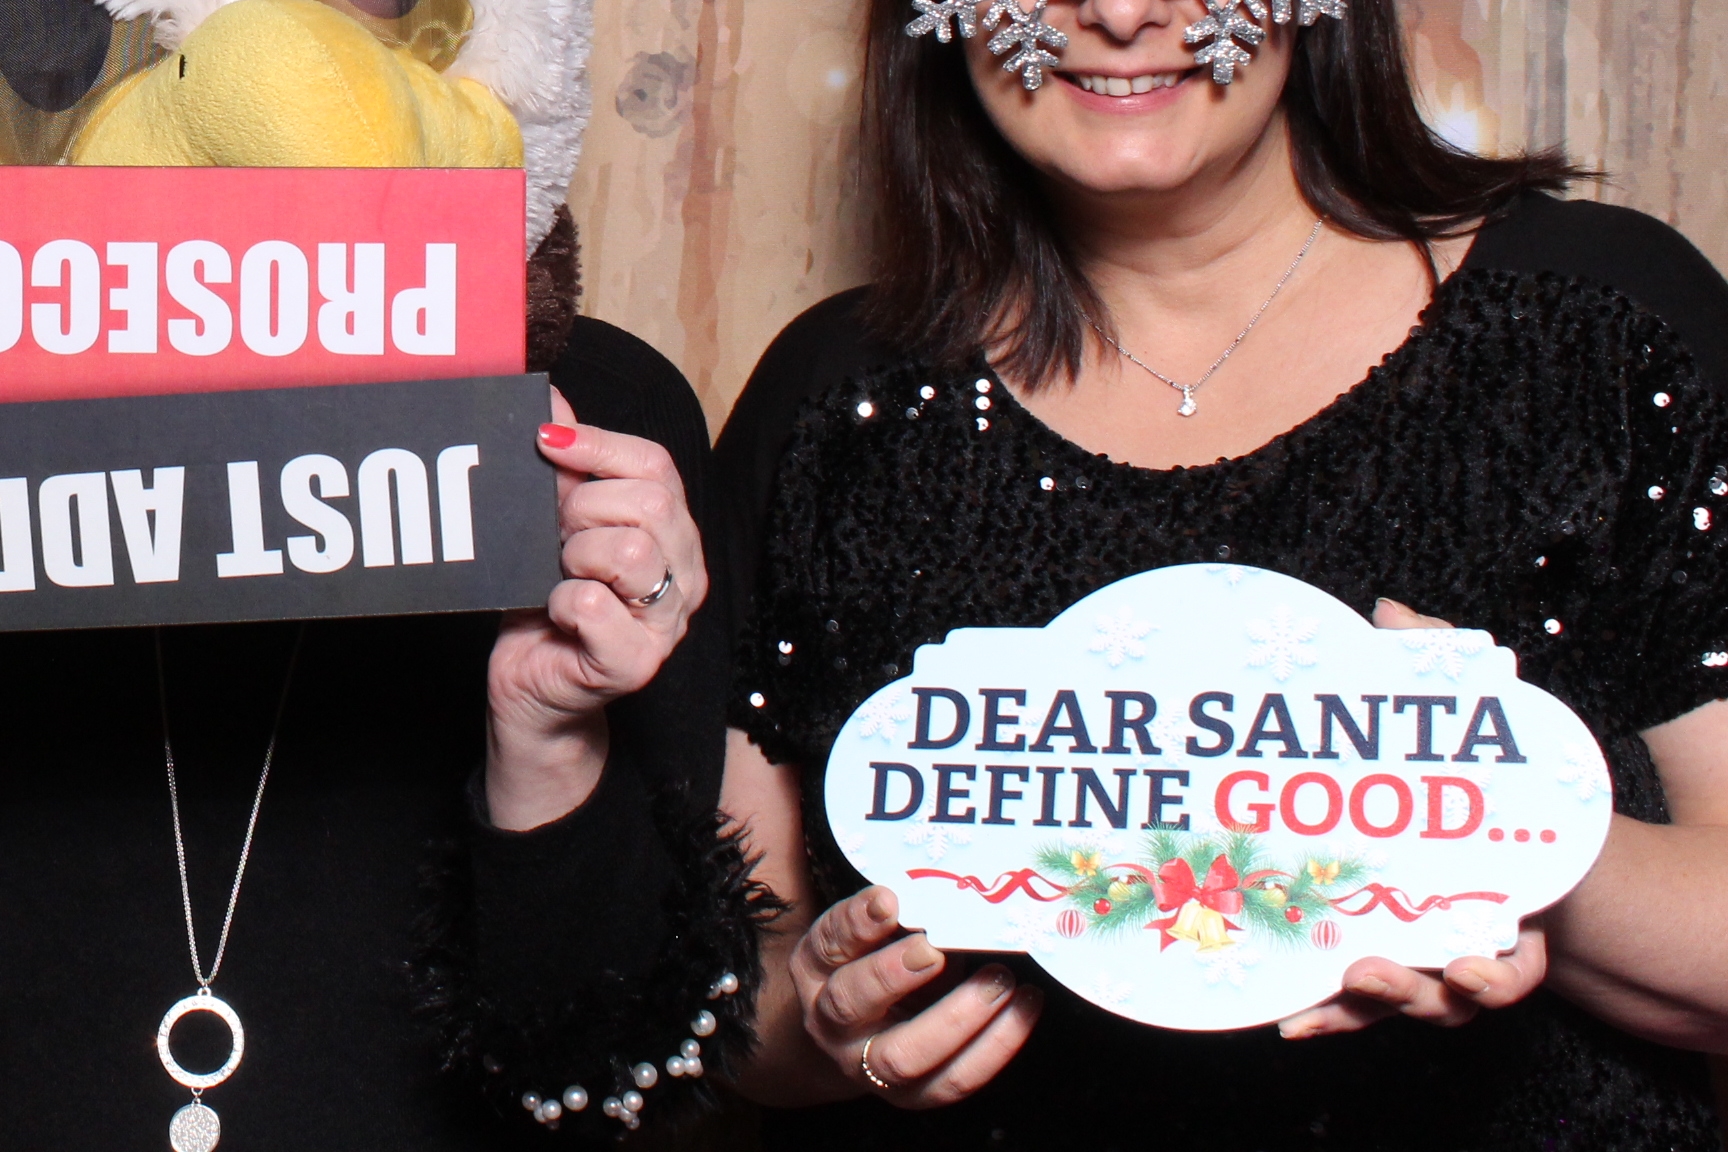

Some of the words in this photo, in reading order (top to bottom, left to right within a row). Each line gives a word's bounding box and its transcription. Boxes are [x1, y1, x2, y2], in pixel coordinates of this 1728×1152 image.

[216, 444, 480, 579] JUST
[907, 686, 1161, 756] DEAR
[1185, 691, 1526, 764] SANTA
[865, 762, 1191, 831] DEFINE
[1214, 770, 1558, 844] GOOD...
